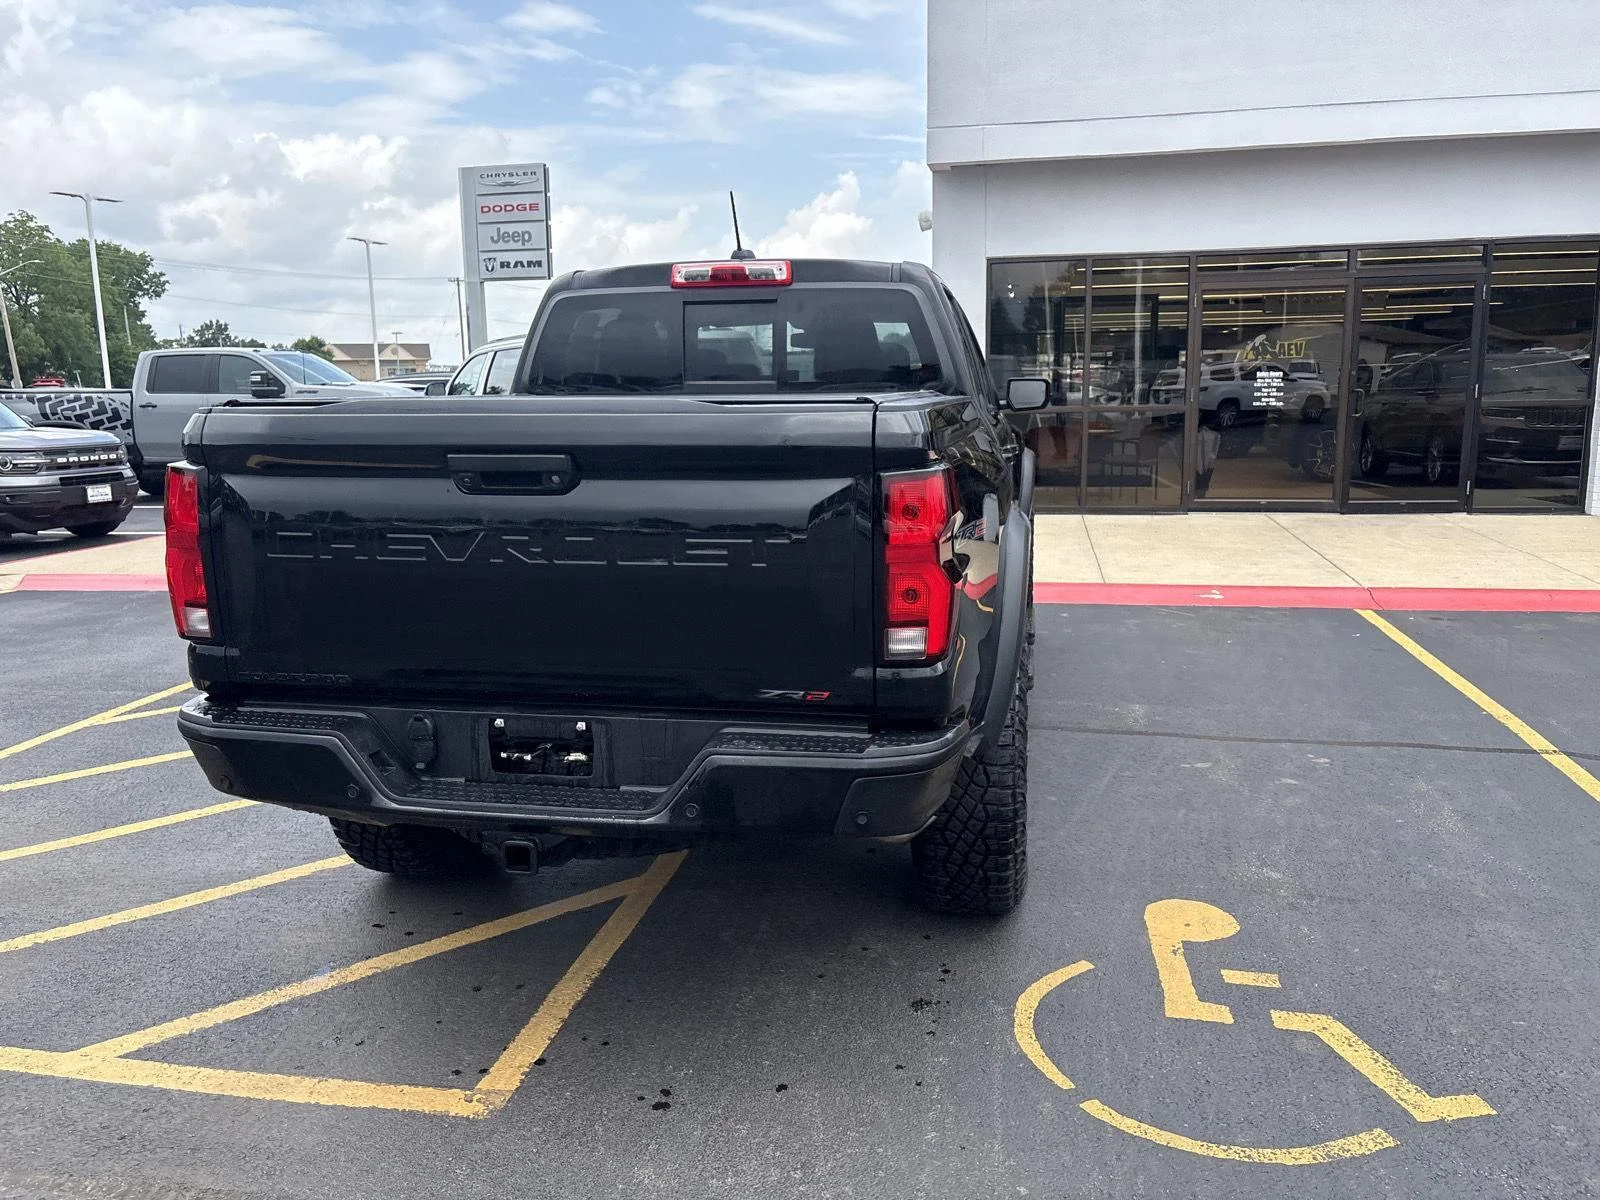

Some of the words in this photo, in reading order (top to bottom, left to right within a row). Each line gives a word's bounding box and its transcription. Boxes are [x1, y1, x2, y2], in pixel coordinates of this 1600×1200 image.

[480, 203, 540, 214] DODGE
[490, 227, 532, 246] Jeep
[500, 260, 543, 269] RAM
[1278, 342, 1304, 357] AEV
[57, 454, 117, 462] BRONCO
[266, 530, 810, 567] CHEVROLET
[757, 689, 832, 701] ZR2
